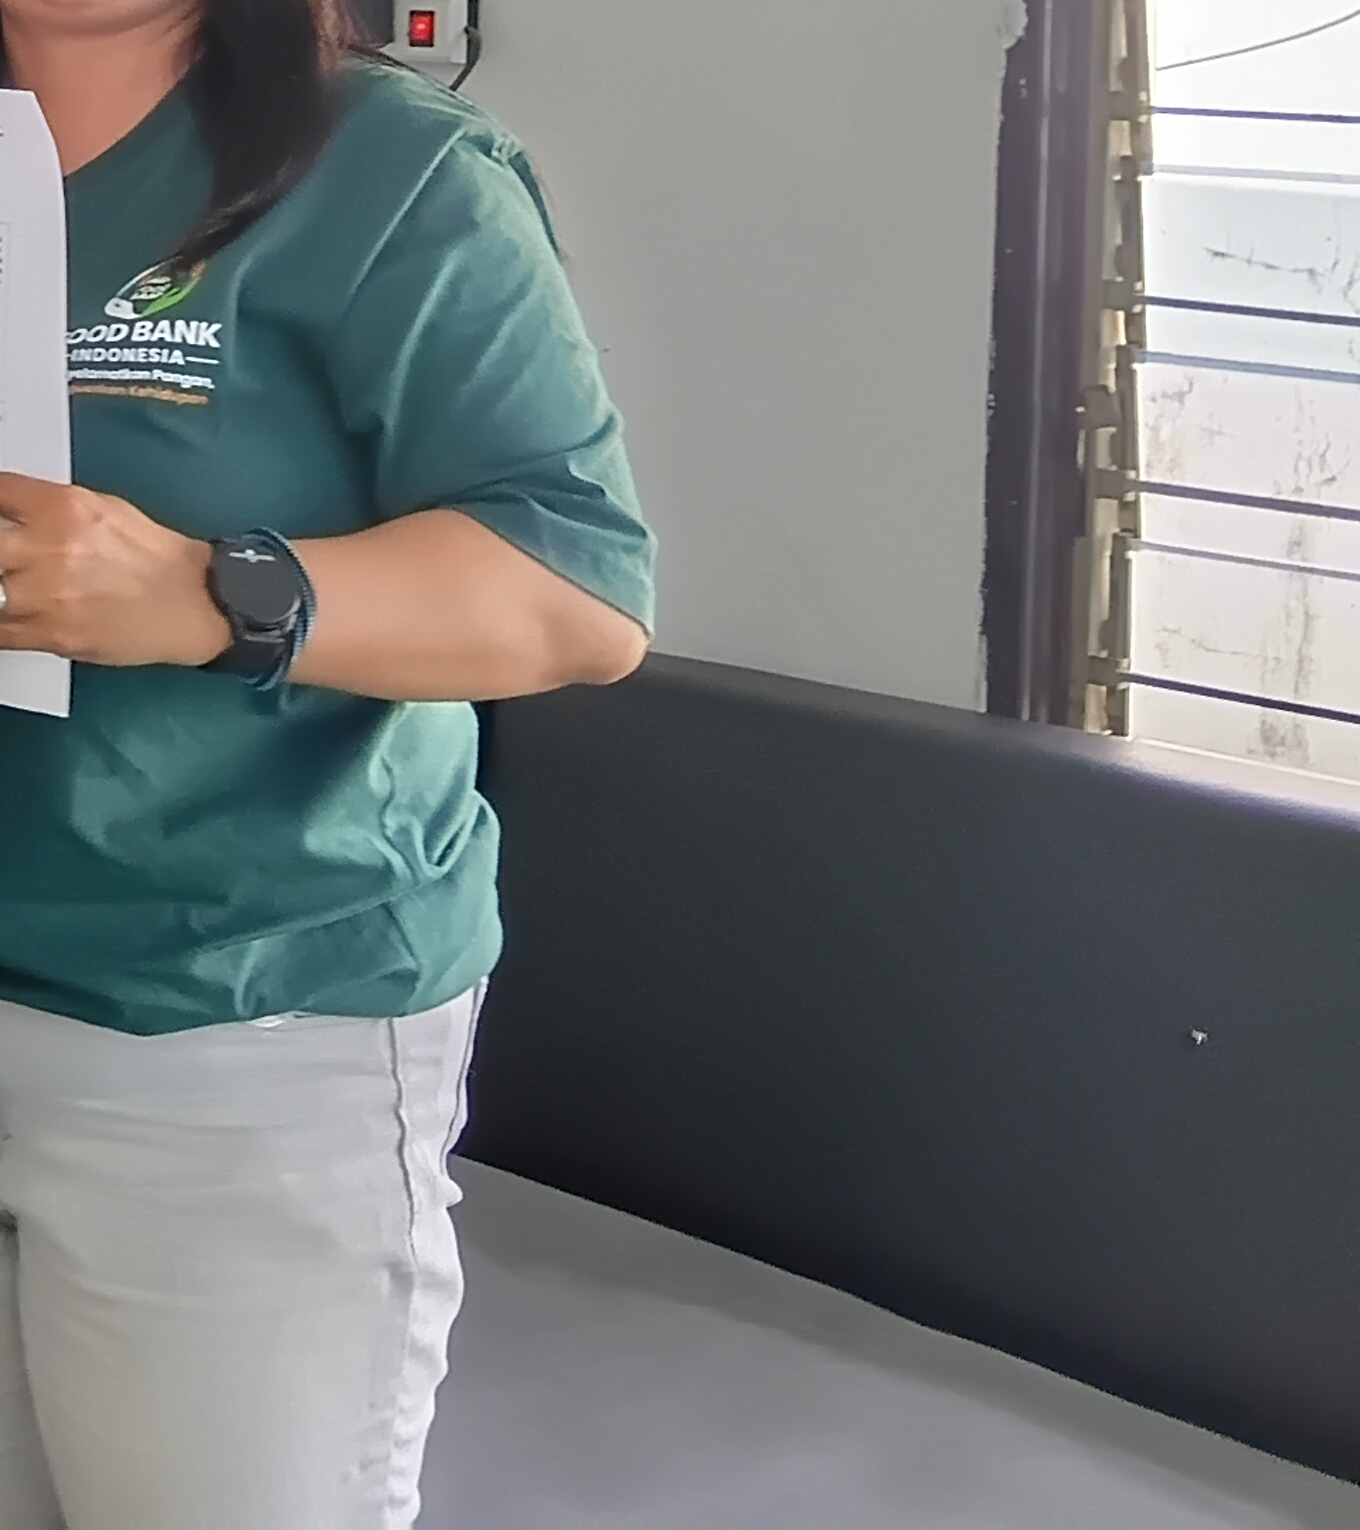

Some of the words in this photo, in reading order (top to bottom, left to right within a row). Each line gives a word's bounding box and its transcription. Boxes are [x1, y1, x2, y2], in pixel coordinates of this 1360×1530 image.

[65, 325, 130, 345] OOD
[130, 319, 223, 348] BANK
[70, 347, 186, 366] INDONESIA
